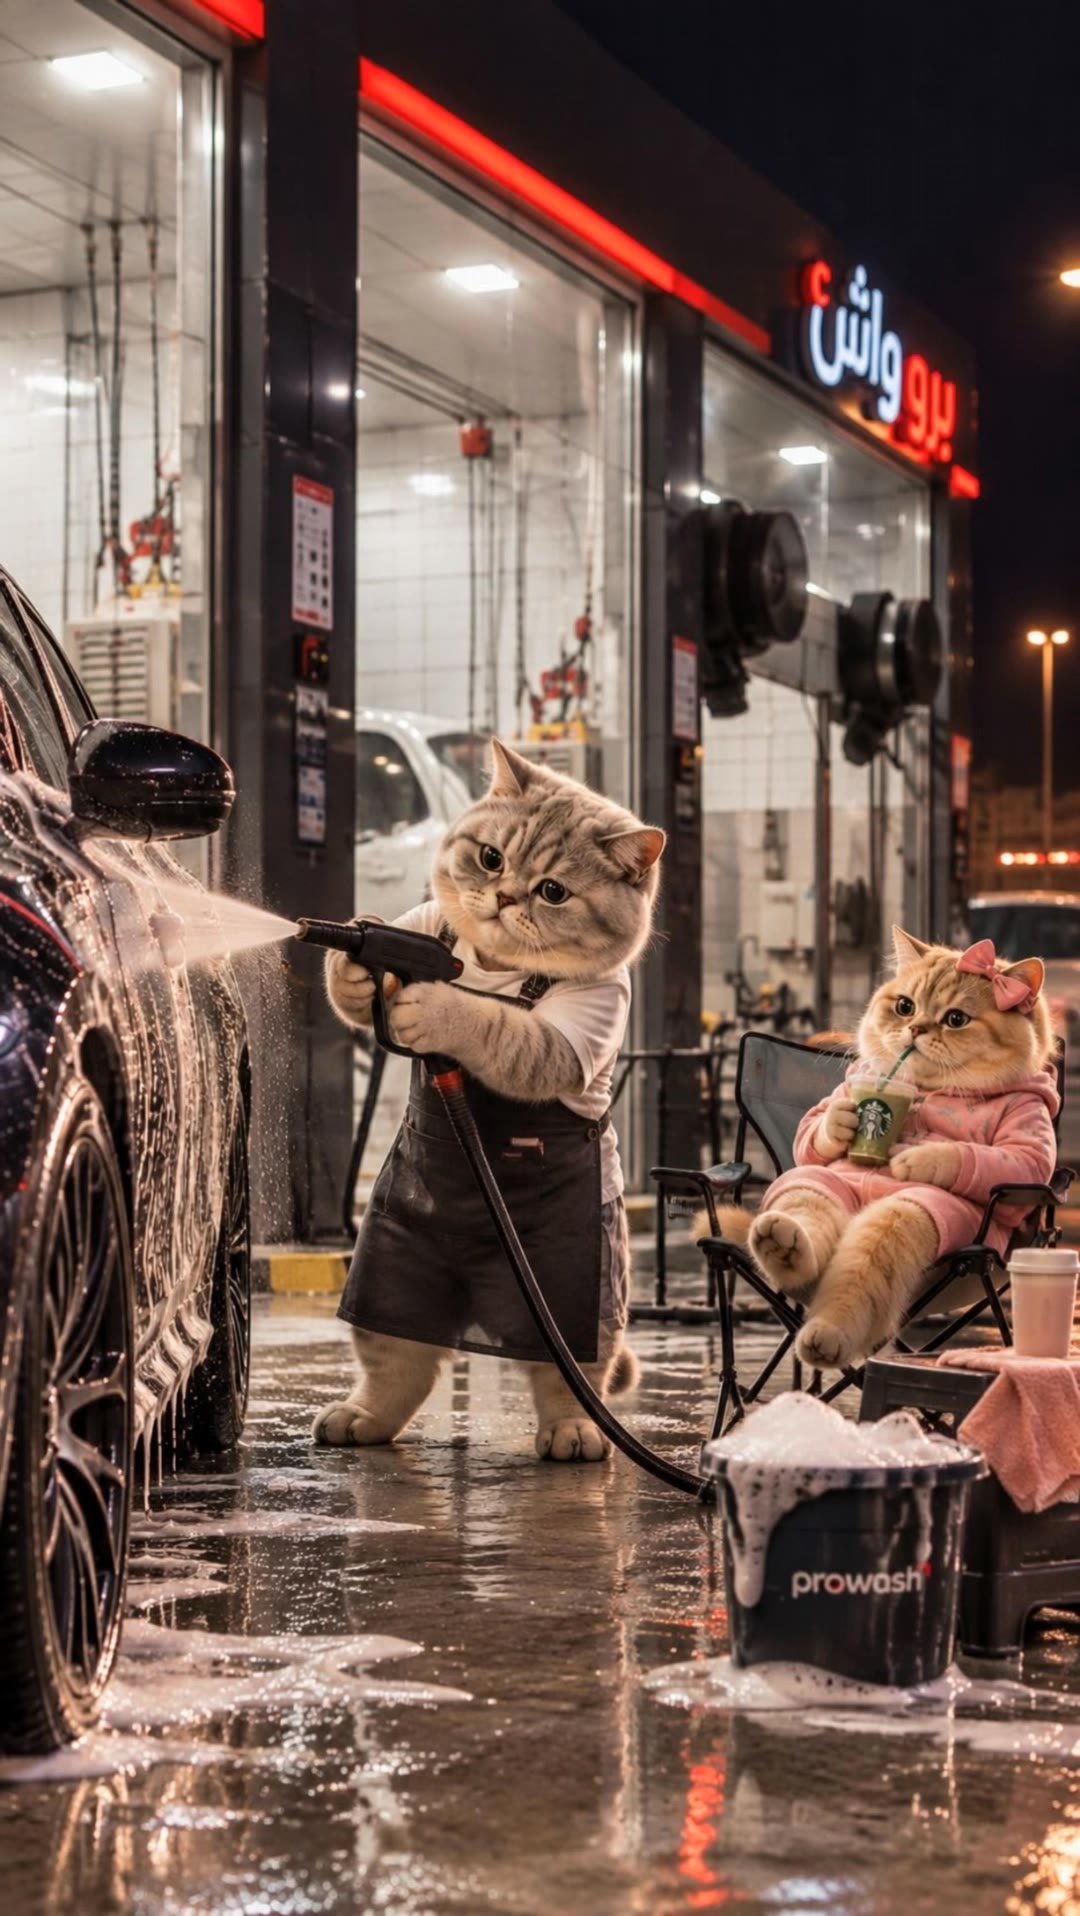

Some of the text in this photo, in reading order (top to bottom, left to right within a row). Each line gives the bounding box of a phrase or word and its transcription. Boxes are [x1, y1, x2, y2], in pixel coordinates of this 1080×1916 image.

[809, 264, 956, 462] برو واش
[791, 1565, 922, 1599] prowash
